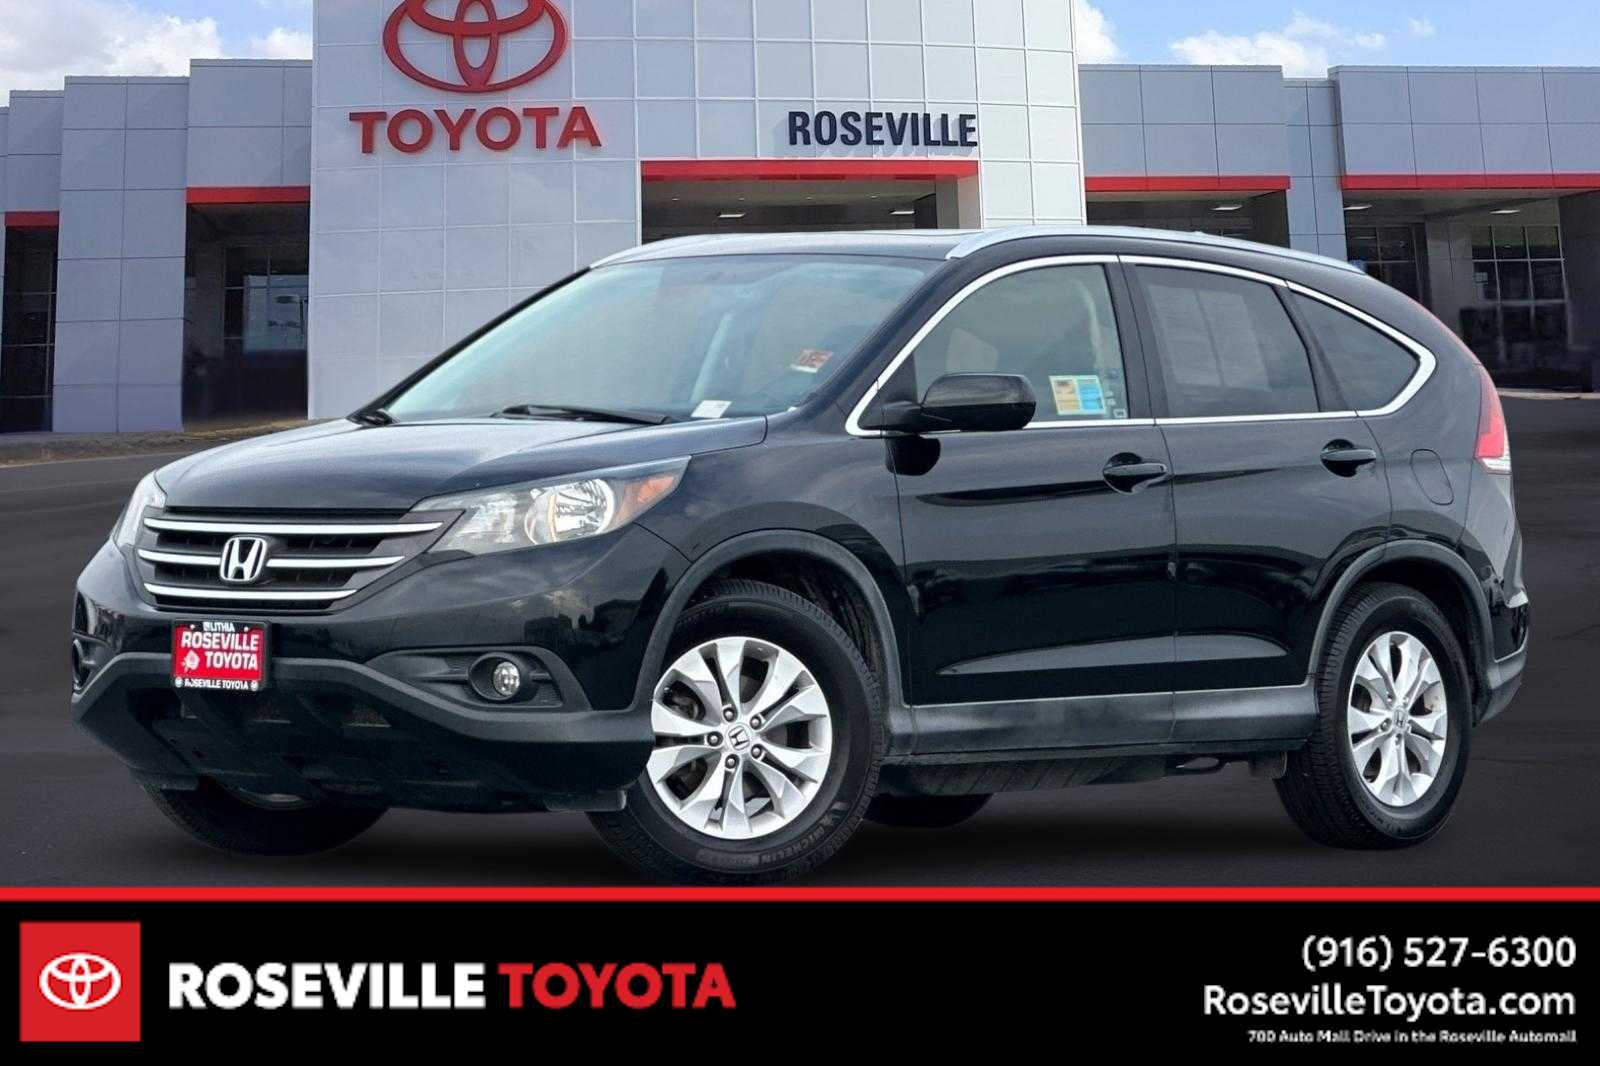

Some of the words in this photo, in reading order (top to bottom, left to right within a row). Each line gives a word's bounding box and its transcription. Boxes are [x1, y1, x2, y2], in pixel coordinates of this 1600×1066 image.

[350, 107, 602, 154] TOYOTA
[788, 110, 979, 147] ROSEVILLE
[210, 621, 236, 632] LITHIA
[181, 631, 260, 651] ROSEVILLE
[204, 651, 258, 671] TOYOTA
[222, 680, 249, 690] TOYOTA
